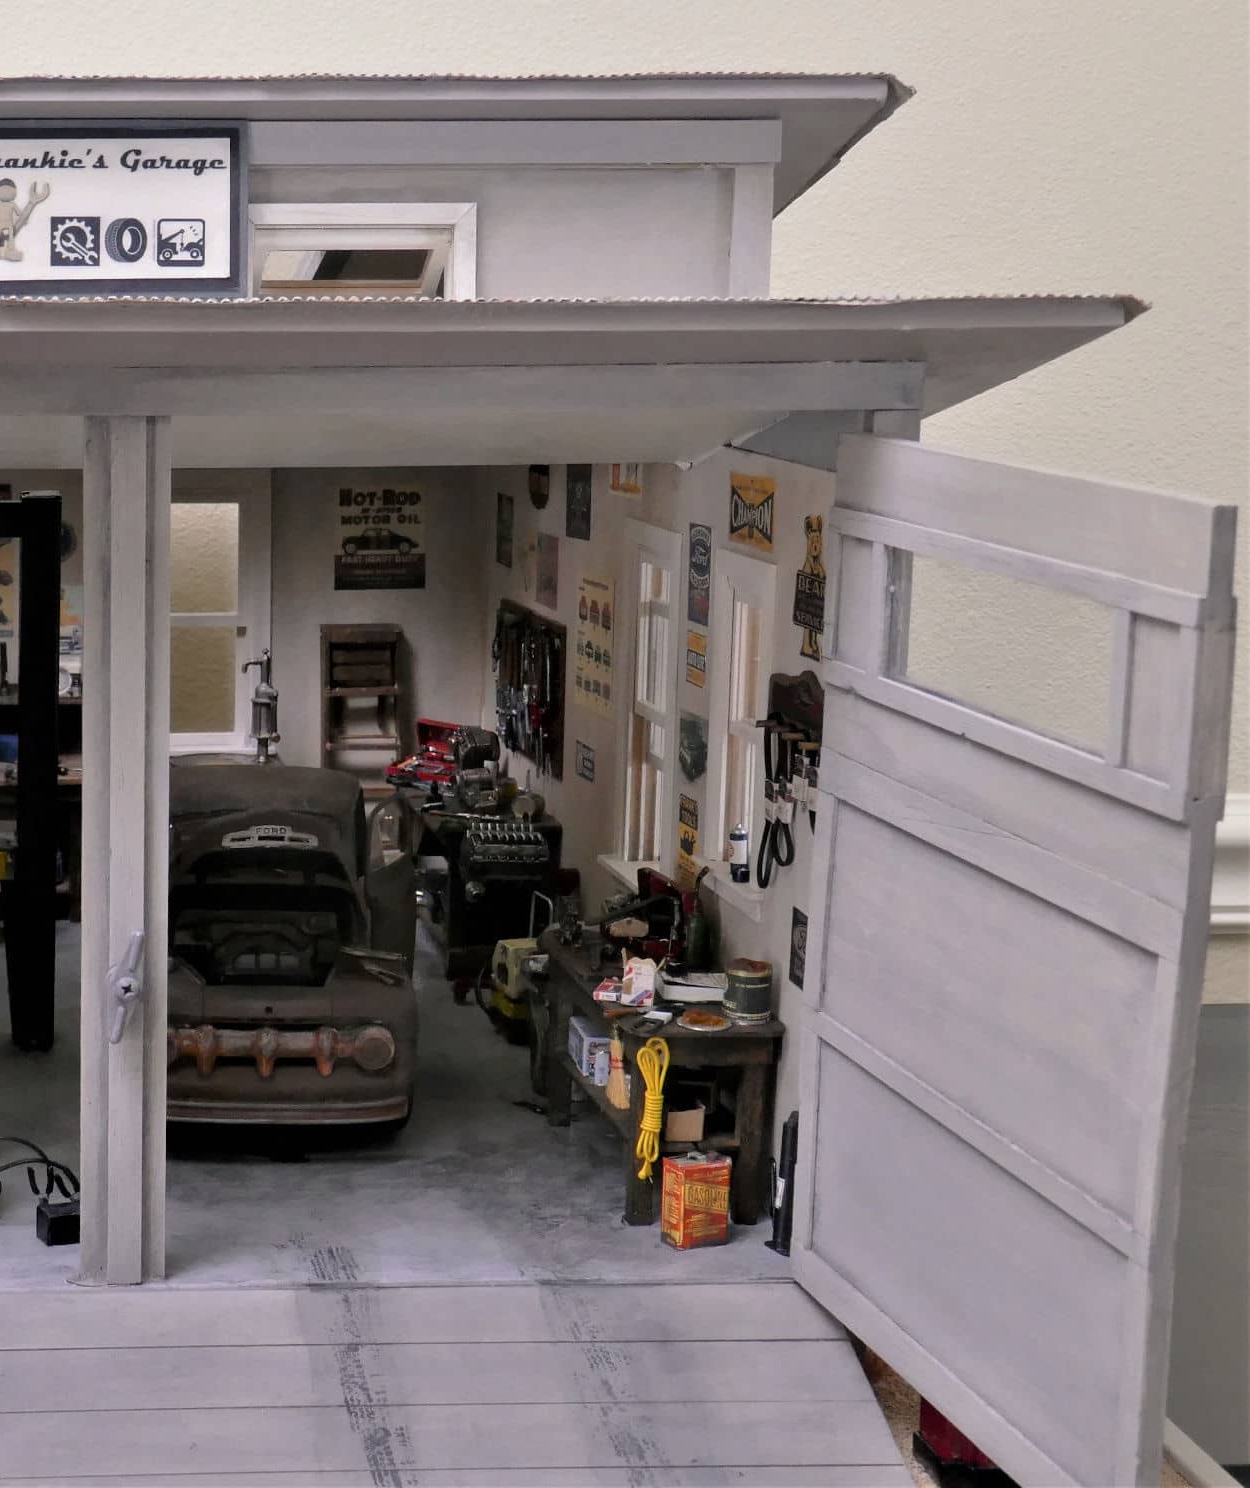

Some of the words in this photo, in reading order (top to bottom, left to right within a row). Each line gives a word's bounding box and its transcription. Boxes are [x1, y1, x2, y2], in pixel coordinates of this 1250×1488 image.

[120, 149, 227, 176] Garage
[341, 515, 390, 525] MOTOR
[398, 514, 421, 524] OIL
[732, 494, 773, 537] CHAMPION
[256, 827, 287, 835] FORD
